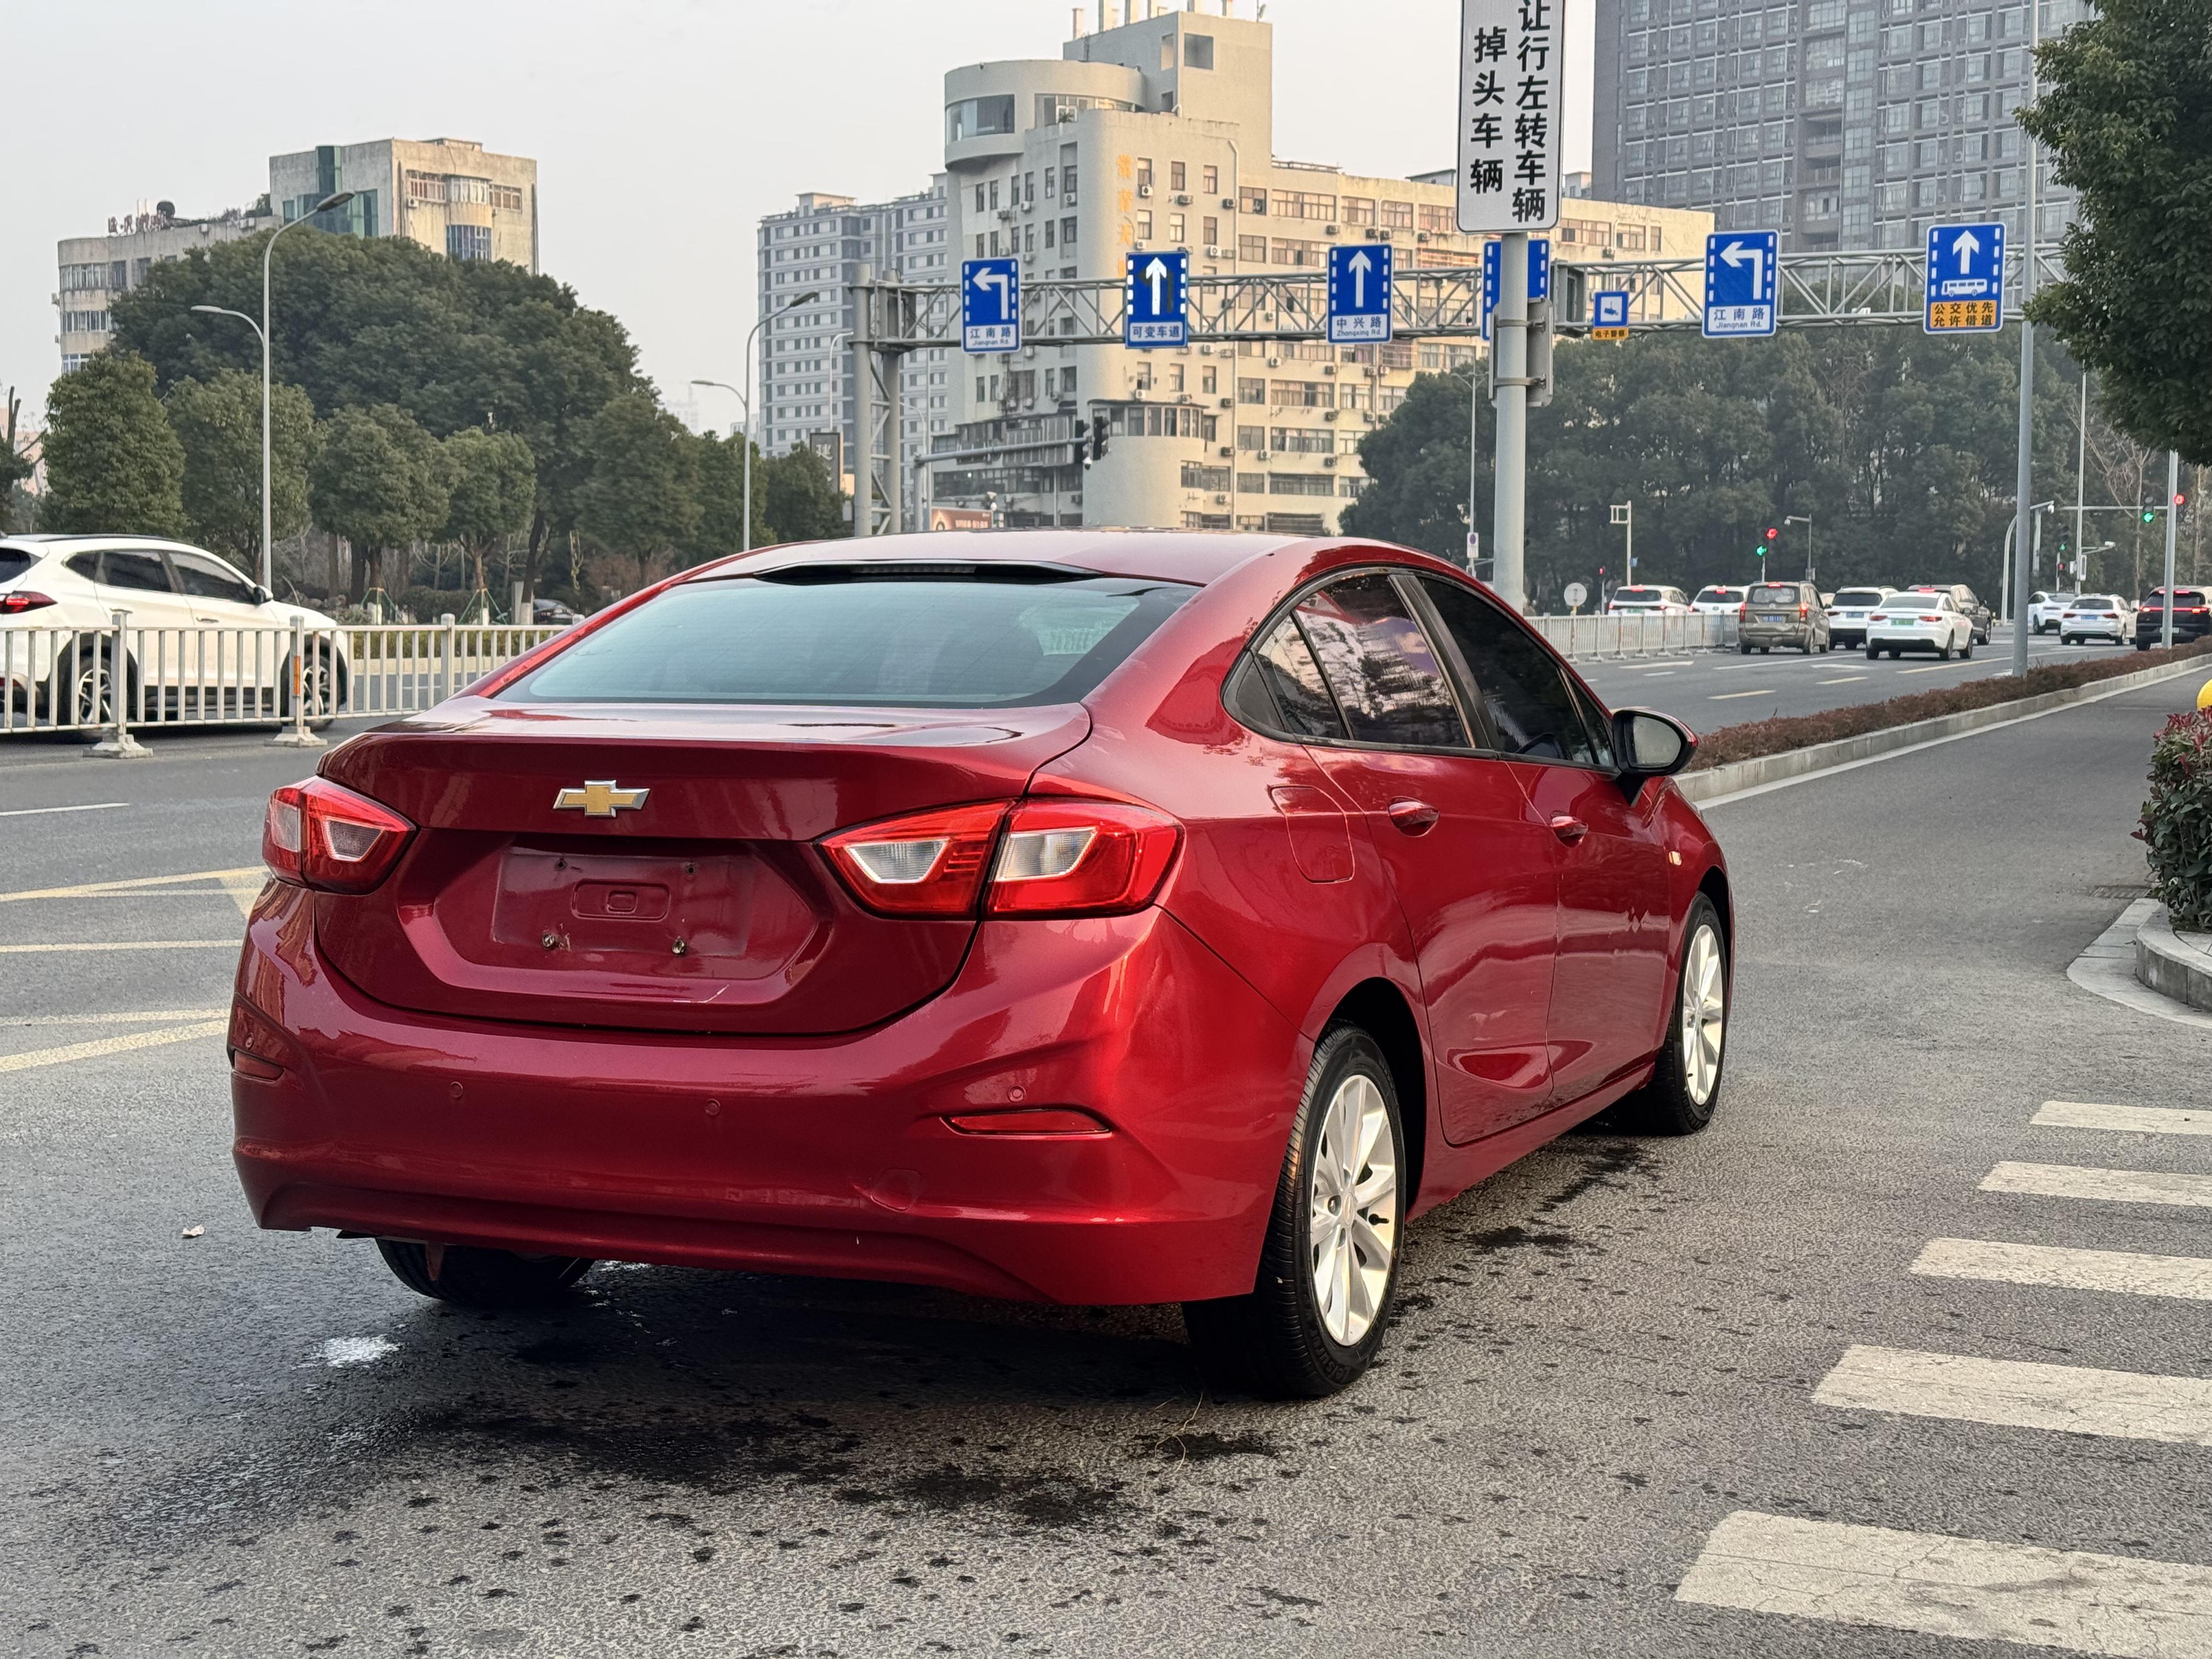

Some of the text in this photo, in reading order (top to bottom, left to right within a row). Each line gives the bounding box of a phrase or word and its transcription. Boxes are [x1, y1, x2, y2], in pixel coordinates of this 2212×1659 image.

[1470, 26, 1508, 194] 掉头车辆
[1512, 0, 1551, 223] 让行左转车辆
[1713, 307, 1765, 321] 江南路
[1934, 301, 1993, 314] 公交优先
[1336, 315, 1381, 330] 中兴路
[1716, 321, 1748, 330] Jiangnan
[1933, 314, 1993, 328] 允许借道
[970, 326, 1011, 339] 江南路
[1132, 325, 1180, 338] 可变车道
